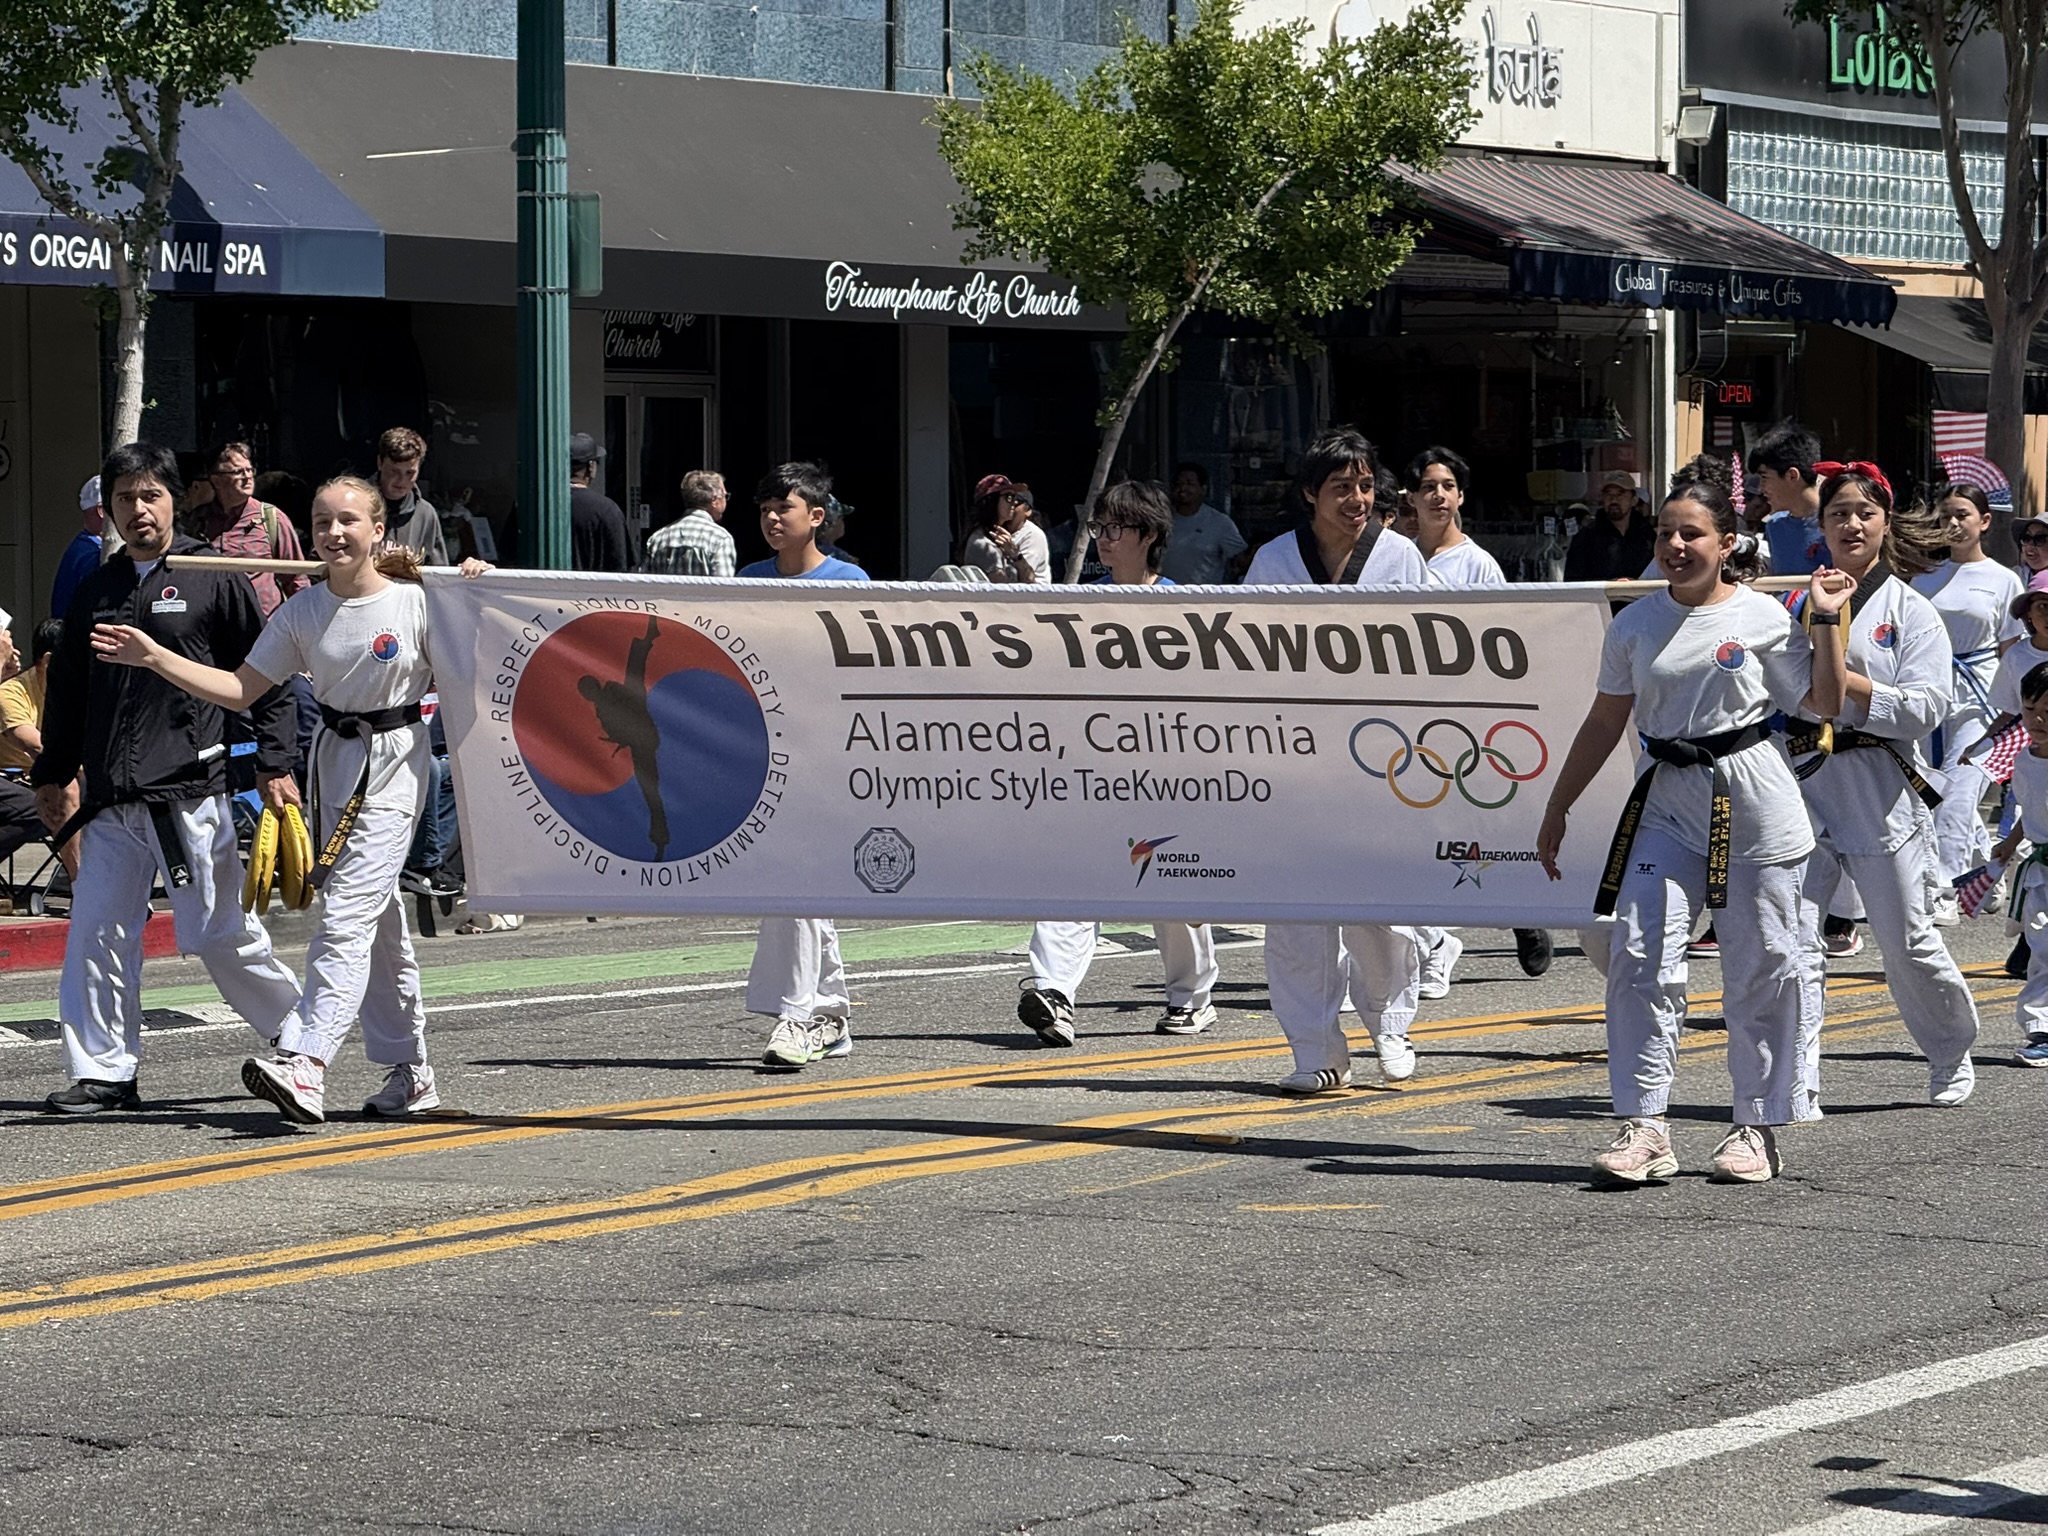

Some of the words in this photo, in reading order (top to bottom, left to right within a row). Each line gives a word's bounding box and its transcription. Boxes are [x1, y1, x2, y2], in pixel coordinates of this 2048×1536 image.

[30, 233, 136, 270] ORGA
[161, 241, 213, 273] NAIL
[223, 242, 267, 275] SPA
[825, 261, 958, 320] Triumphant
[958, 271, 1002, 325] Life
[1004, 274, 1082, 318] Church
[1615, 263, 1656, 293] Global
[1658, 267, 1714, 296] Treasures
[1718, 280, 1726, 297] &
[1731, 275, 1771, 310] Unique
[605, 328, 662, 358] Church
[1719, 384, 1752, 403] OPEN
[570, 597, 660, 615] HONOR
[815, 609, 1033, 669] Lim's
[1033, 611, 1529, 681] TaeKwonDo
[491, 614, 550, 723] RESPECT
[694, 615, 785, 718] MODESTY
[845, 711, 1066, 760] Alameda,
[1084, 711, 1316, 755] California
[849, 767, 981, 809] Olympic
[990, 767, 1068, 810] Style
[1074, 769, 1272, 803] TaeKwonDo
[501, 754, 610, 875] DISCIPLINE
[640, 751, 789, 887] DETERMINATION
[1721, 796, 1730, 819] LIM'S
[1720, 822, 1729, 840] TAE
[1156, 853, 1200, 863] WORLD
[1436, 841, 1481, 860] USA
[1481, 851, 1541, 862] TAEKWON
[1718, 843, 1728, 869] KWON
[1156, 868, 1236, 878] TAEKWONDO
[1717, 871, 1726, 884] DO
